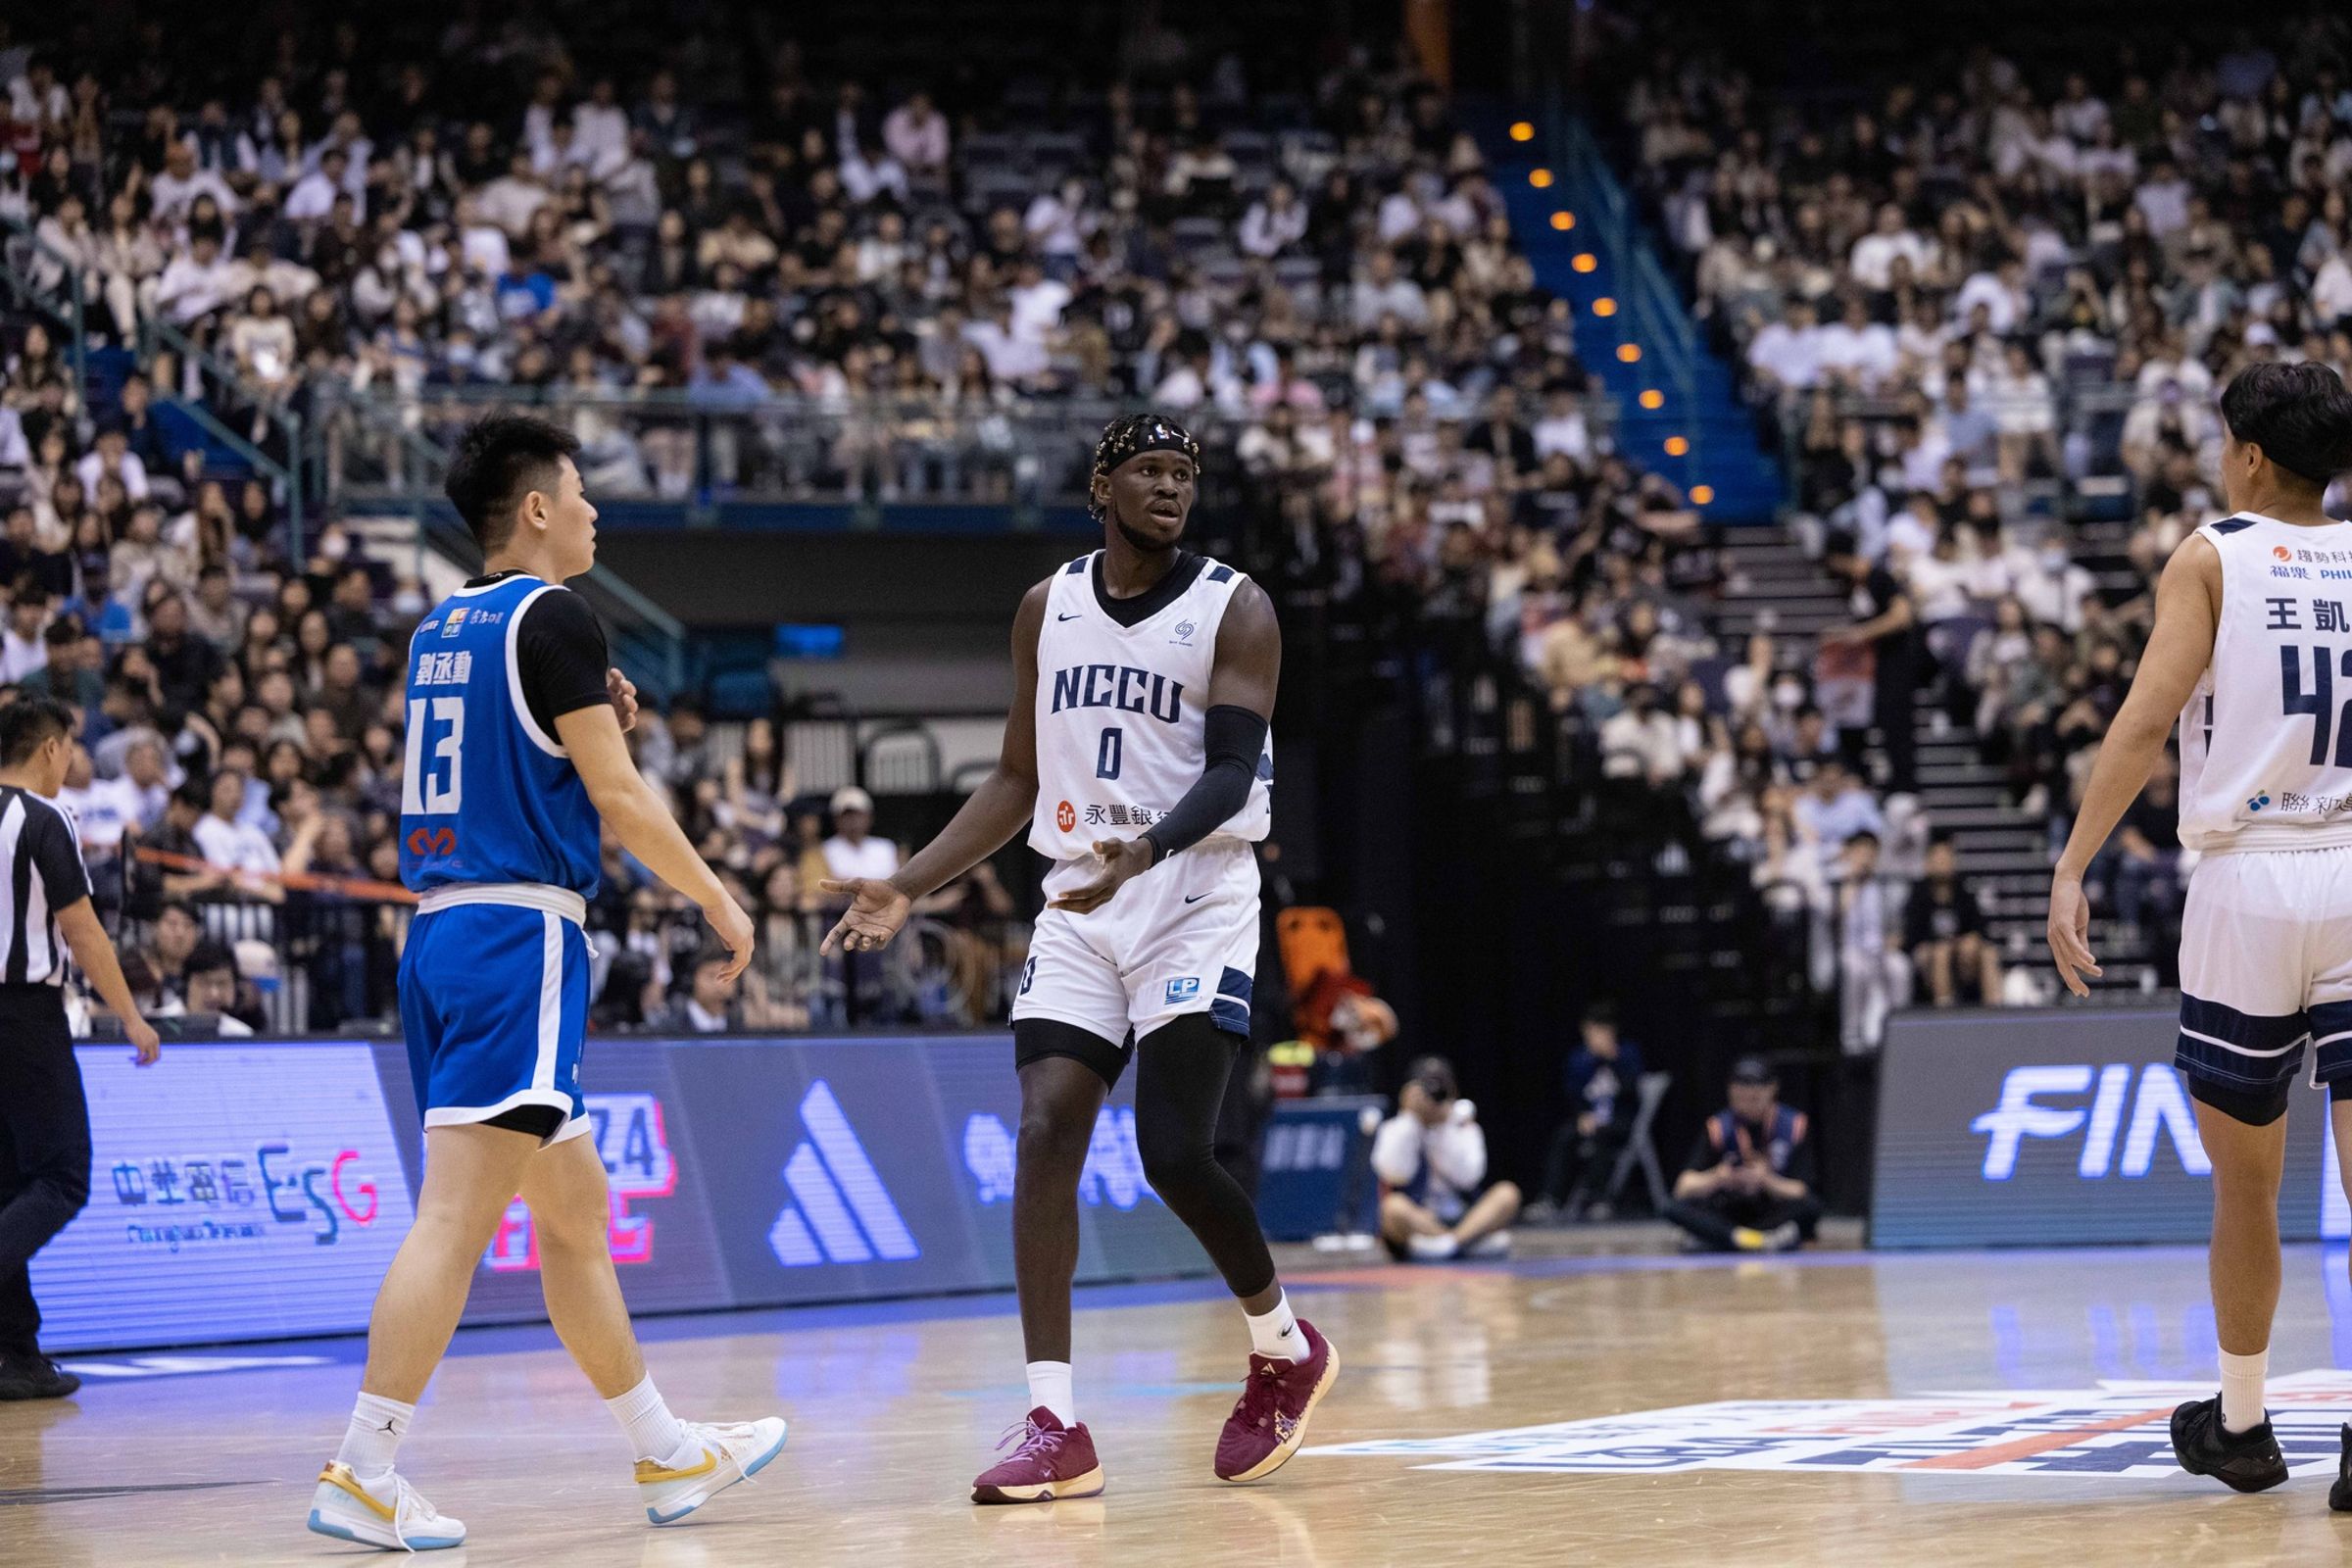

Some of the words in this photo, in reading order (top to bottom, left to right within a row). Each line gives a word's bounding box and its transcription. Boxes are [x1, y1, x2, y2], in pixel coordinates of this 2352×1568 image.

[2296, 548, 2352, 564] 趨勢科
[2266, 598, 2350, 632] 王凱
[1051, 664, 1185, 723] NCCU
[401, 697, 465, 815] 13
[1097, 727, 1123, 780] 0
[1168, 978, 1198, 995] LP
